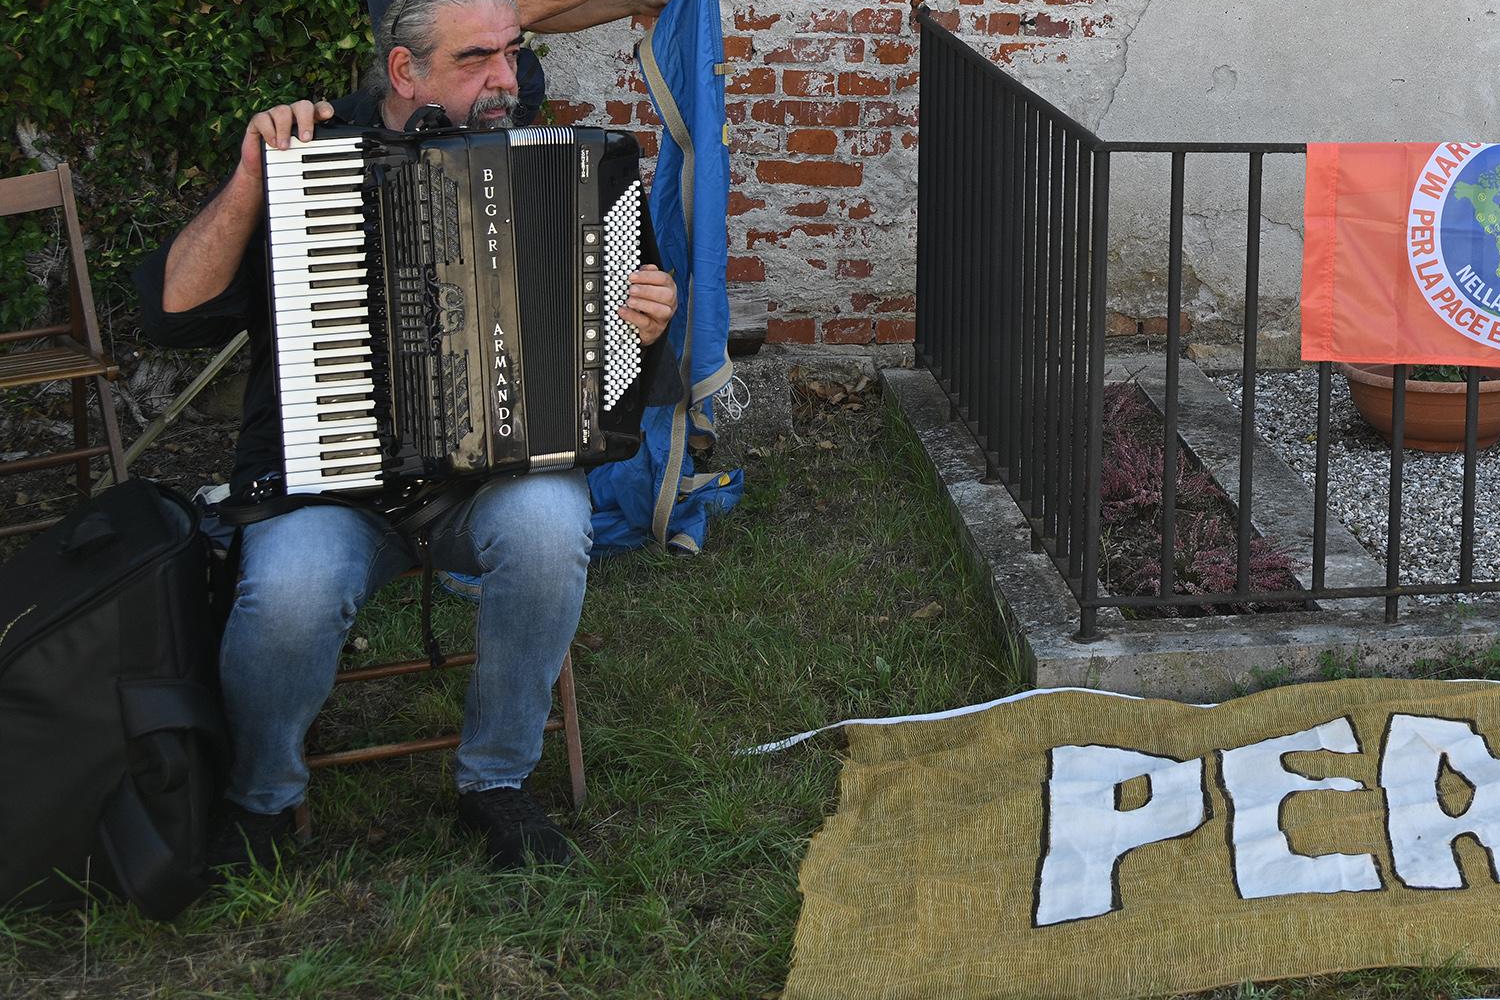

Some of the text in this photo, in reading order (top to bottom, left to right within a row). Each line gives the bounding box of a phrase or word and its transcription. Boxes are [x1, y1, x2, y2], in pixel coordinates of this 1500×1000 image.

[483, 168, 498, 269] BUGARI
[1411, 209, 1436, 258] PER
[1416, 259, 1445, 291] LA
[1431, 291, 1491, 336] PACE
[494, 323, 511, 437] ARMANDO
